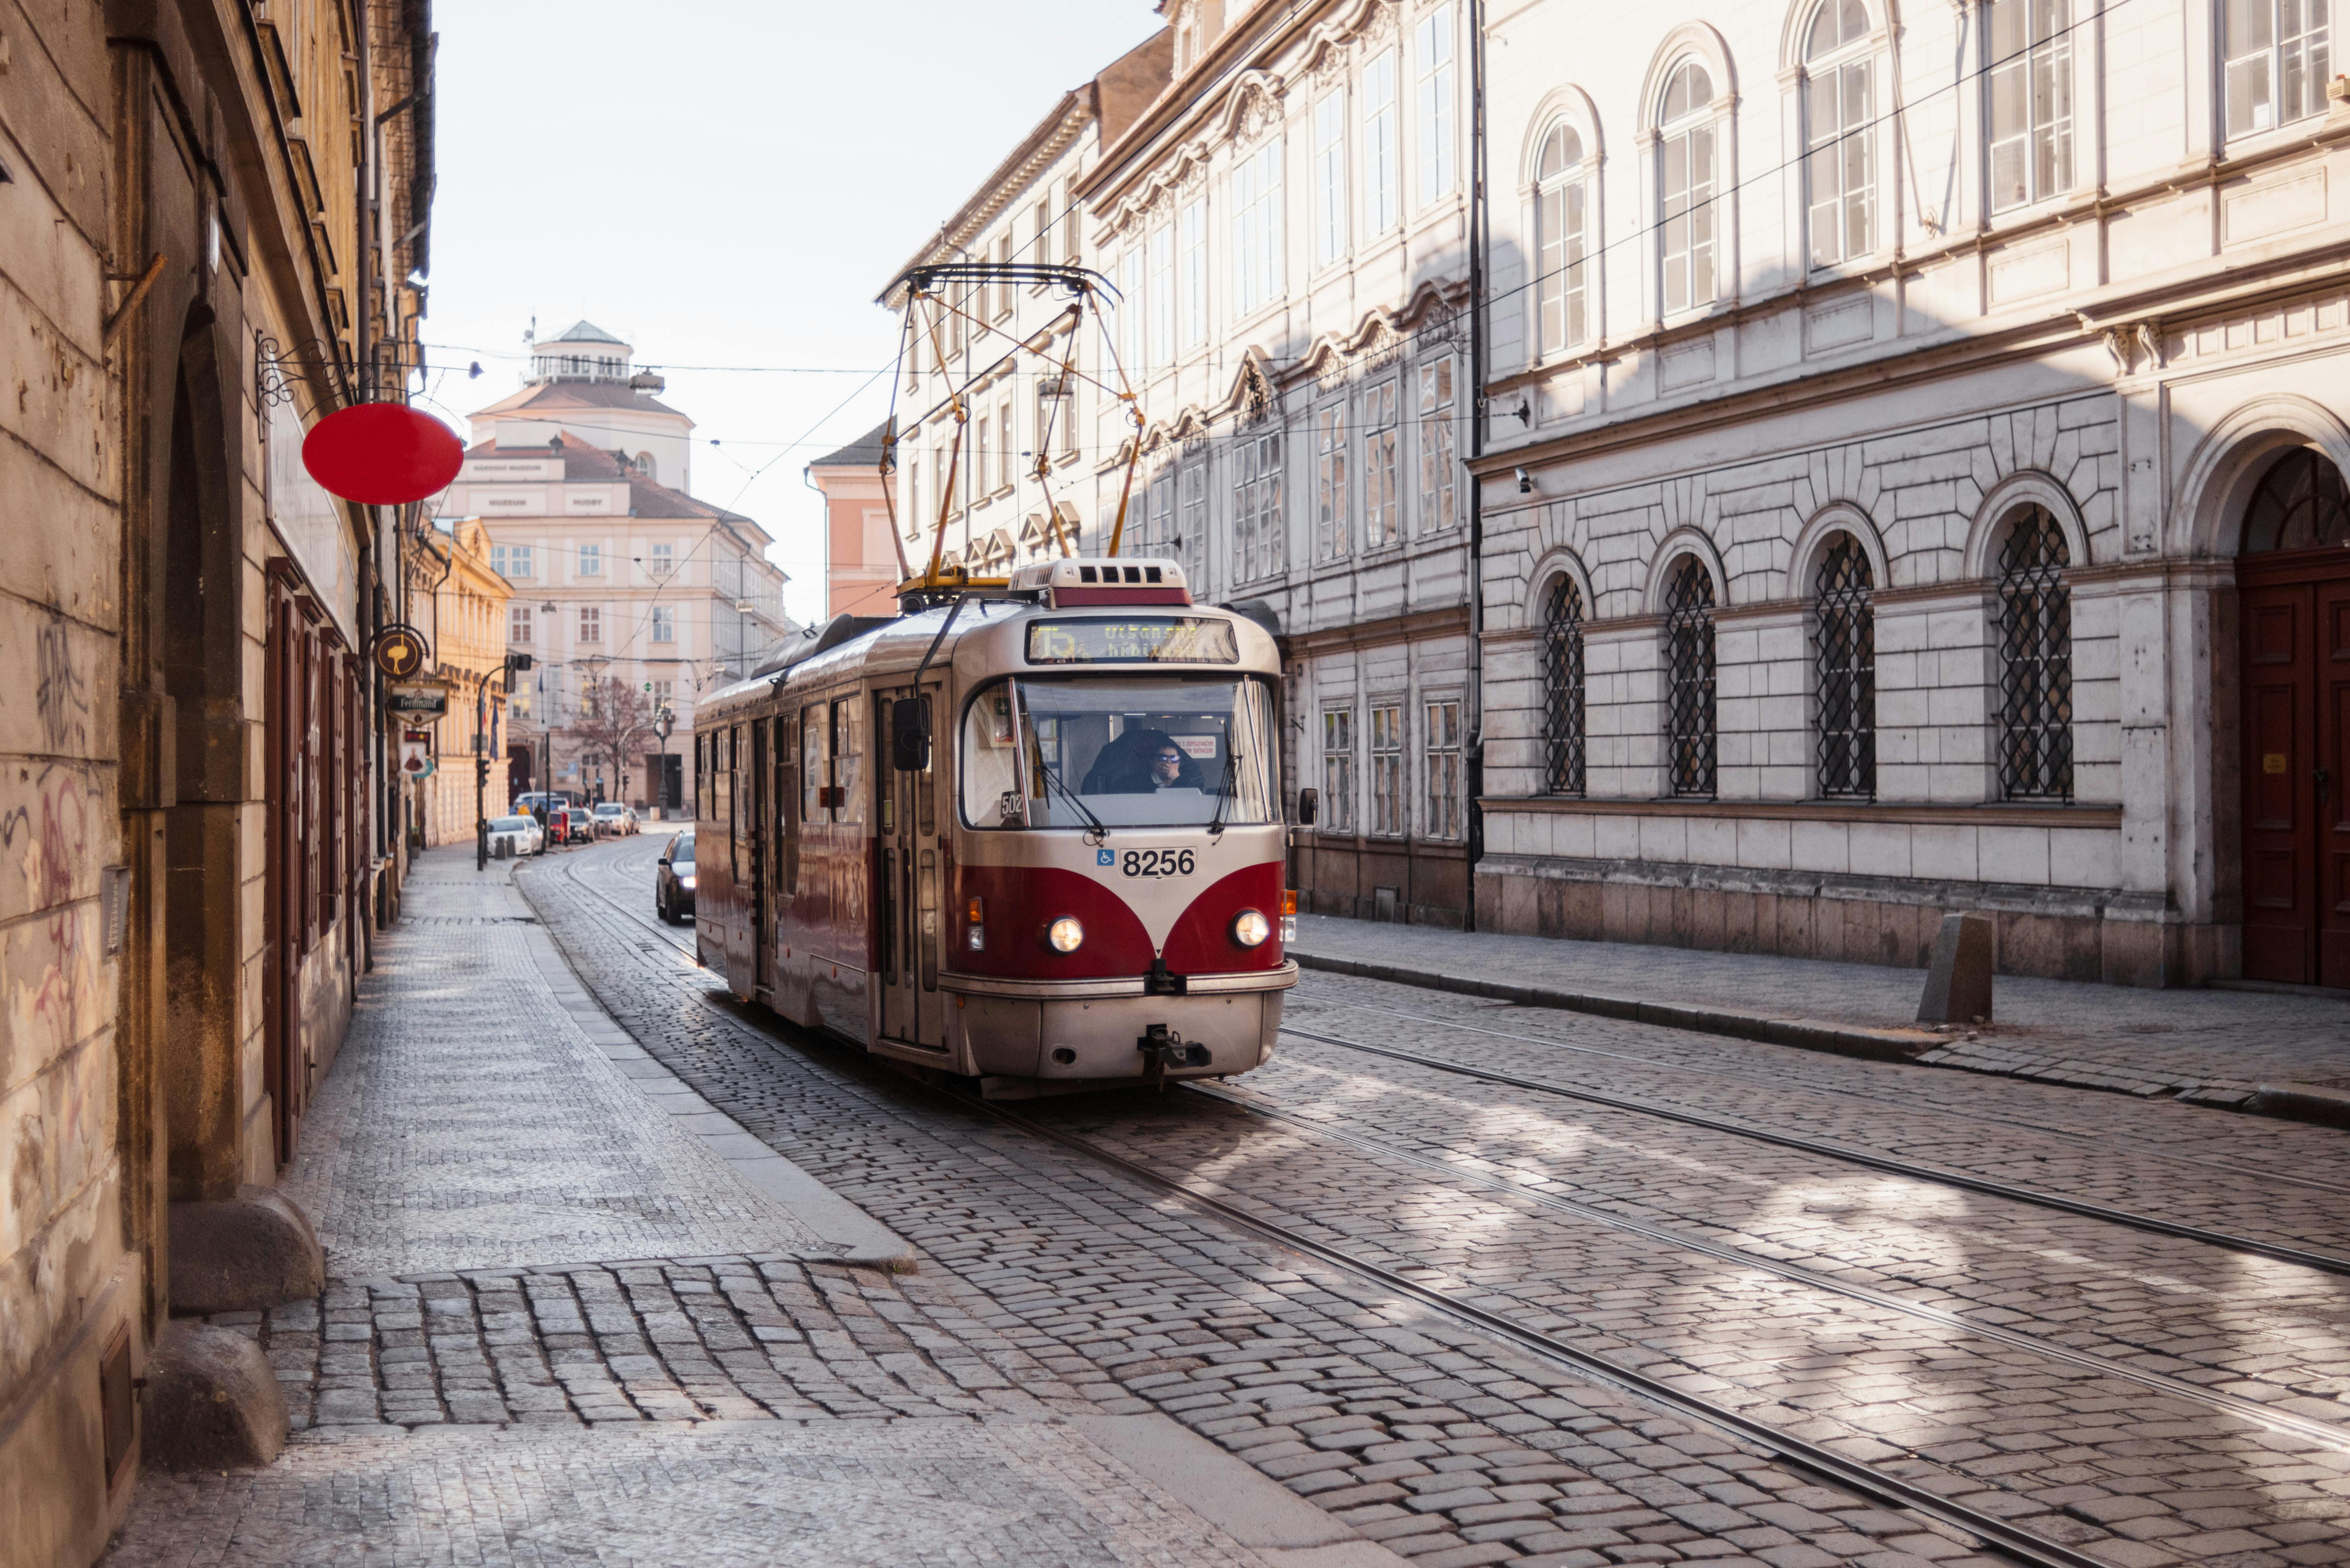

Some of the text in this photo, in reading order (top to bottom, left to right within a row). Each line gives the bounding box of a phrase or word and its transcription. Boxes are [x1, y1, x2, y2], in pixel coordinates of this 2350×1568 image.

[401, 698, 436, 708] Ferdinand
[1002, 794, 1023, 814] 502
[1123, 849, 1195, 877] 8256
